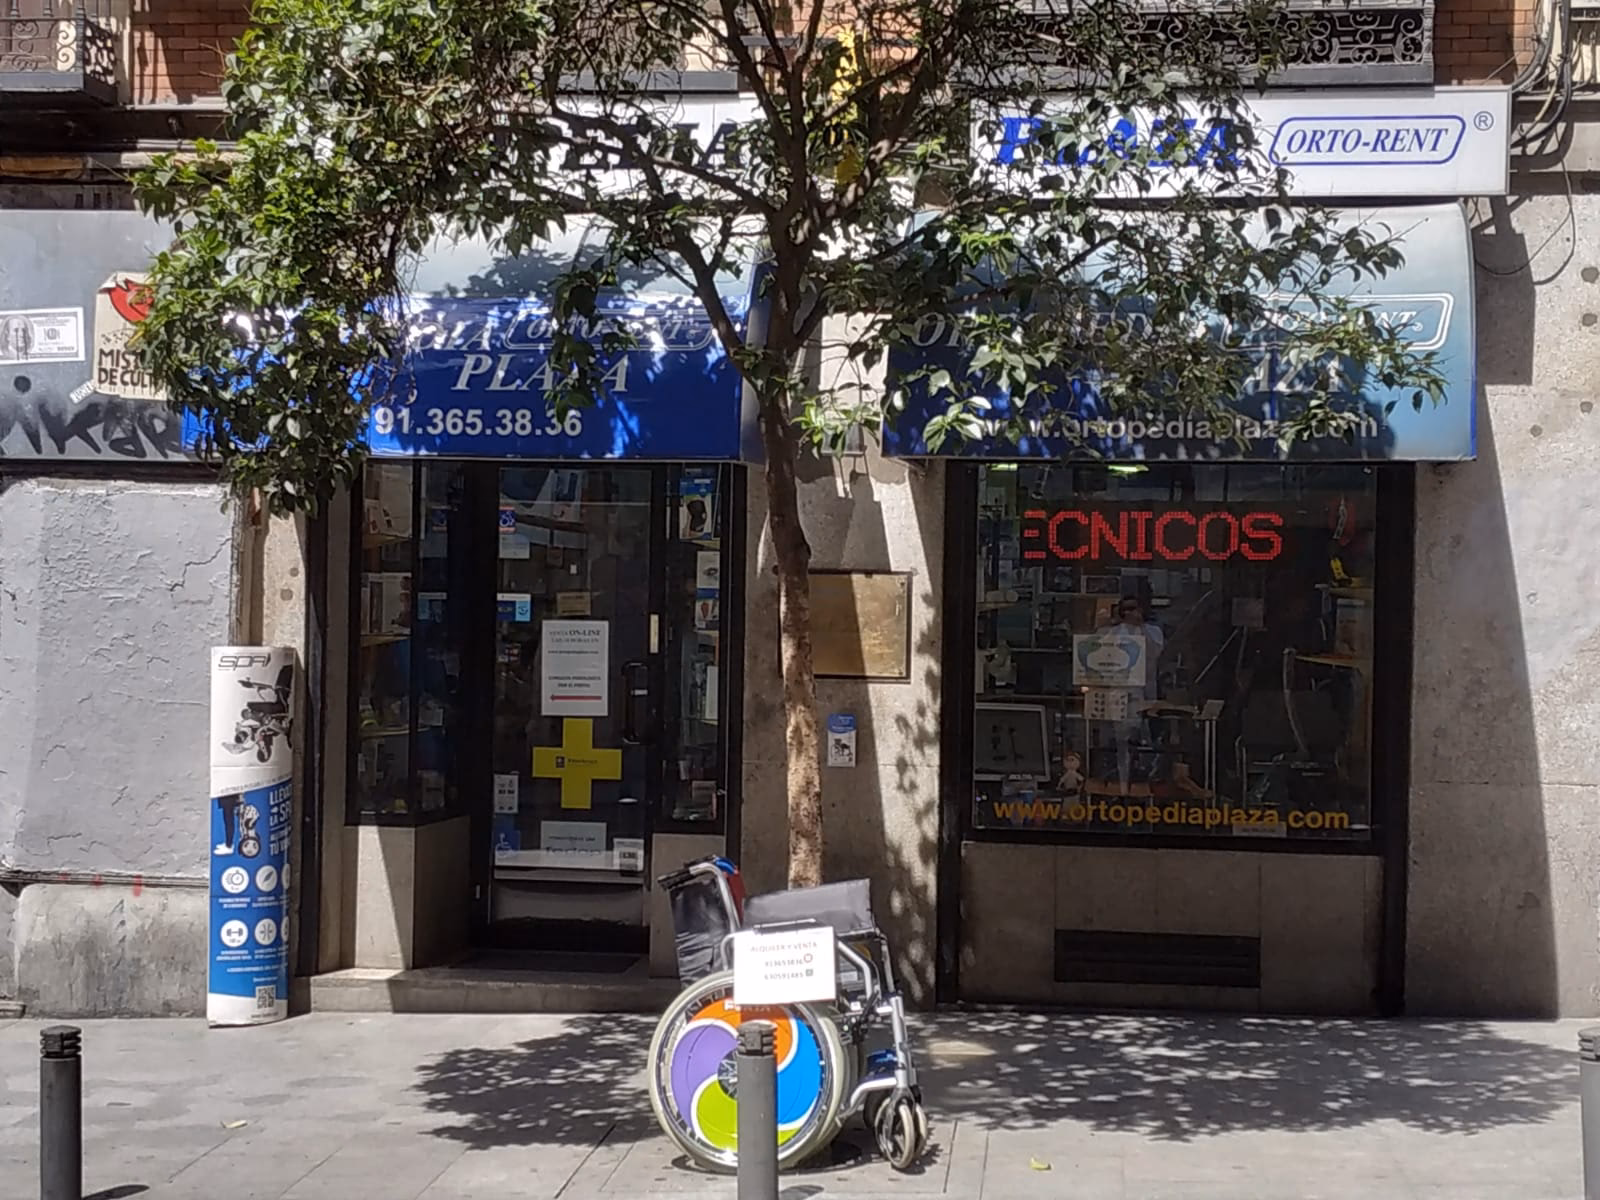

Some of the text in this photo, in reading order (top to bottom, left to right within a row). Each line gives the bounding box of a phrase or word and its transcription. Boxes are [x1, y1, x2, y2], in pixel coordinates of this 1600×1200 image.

[1287, 128, 1449, 154] ORTO-RENT
[98, 367, 118, 386] DE
[451, 353, 628, 393] PLAA
[374, 407, 582, 436] 91.365.38.36
[983, 415, 1378, 443] ww.ortopediaplaz.com
[1024, 511, 1283, 560] ECNICOS
[993, 800, 1350, 829] www.ortopediaplaza.com
